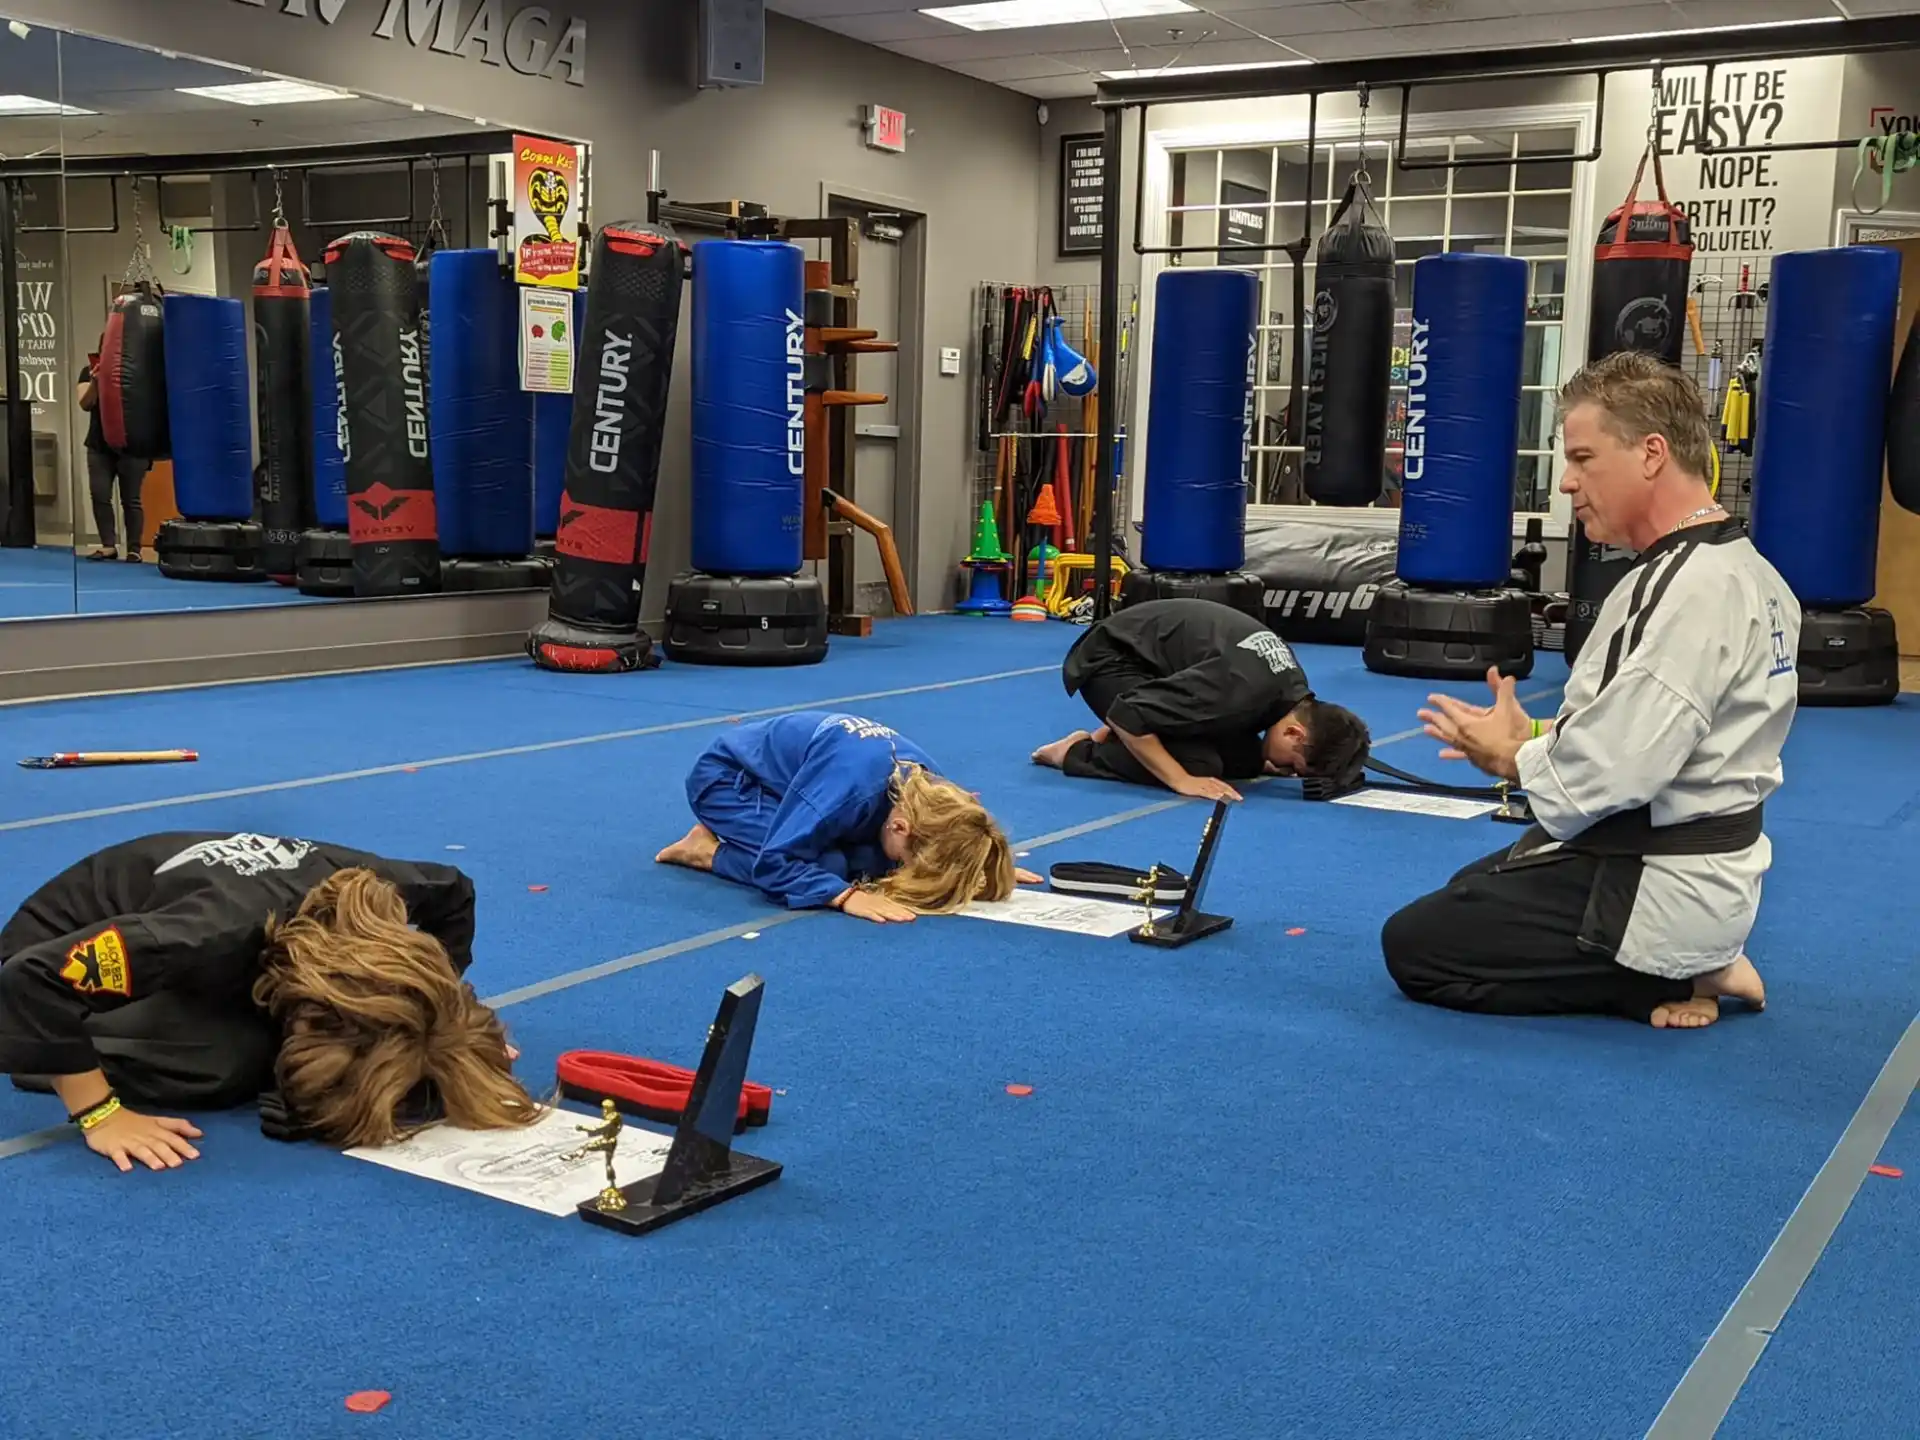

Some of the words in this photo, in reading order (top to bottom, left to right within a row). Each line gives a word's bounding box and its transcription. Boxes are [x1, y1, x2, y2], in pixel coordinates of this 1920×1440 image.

[372, 0, 587, 87] MAGA
[1659, 76, 1716, 107] WIL
[1724, 72, 1747, 102] IT
[1754, 70, 1786, 100] BE
[879, 109, 904, 145] EXIT
[1657, 102, 1784, 156] EASY?
[1700, 155, 1778, 189] NOPE.
[1740, 198, 1776, 226] IT?
[1690, 230, 1773, 252] SOLUTELY.
[786, 308, 804, 475] CENTURY
[761, 617, 769, 631] 5
[99, 952, 111, 977] CLUB
[103, 935, 121, 965] BLACK
[111, 967, 123, 988] BELT
